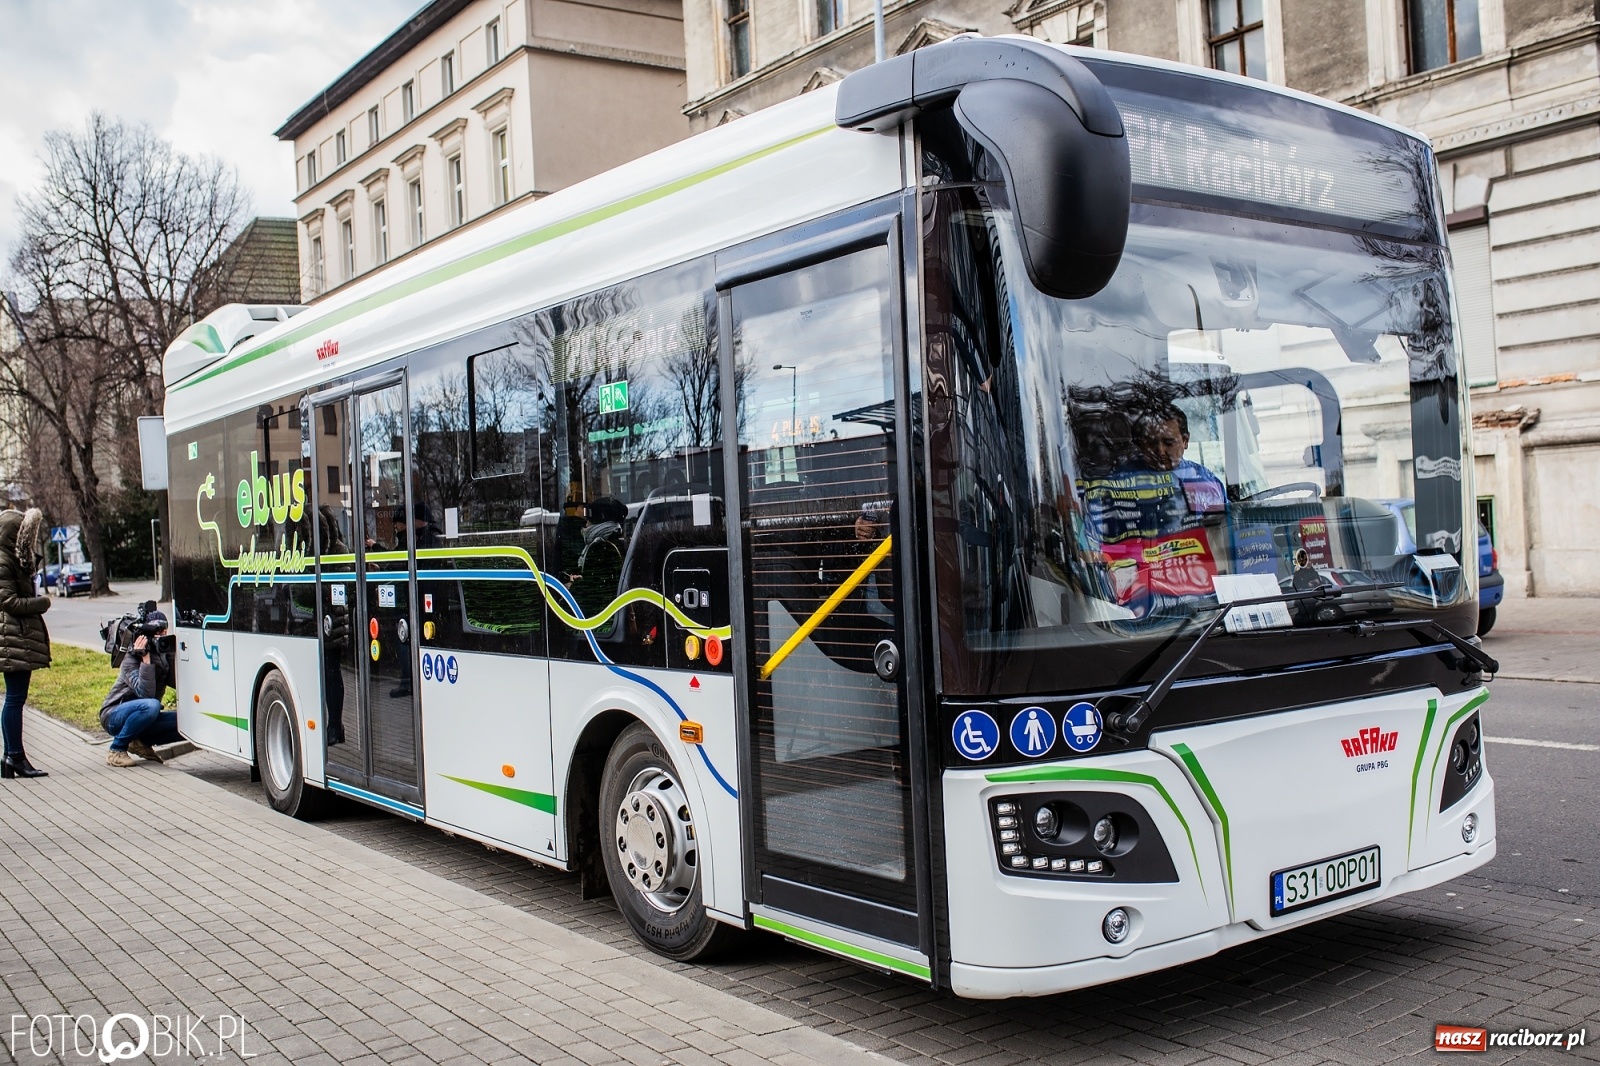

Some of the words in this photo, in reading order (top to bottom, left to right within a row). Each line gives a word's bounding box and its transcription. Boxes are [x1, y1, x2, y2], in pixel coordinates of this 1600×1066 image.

[1186, 125, 1335, 208] Racibórz
[236, 450, 305, 528] ebus
[237, 534, 277, 587] jedyny
[279, 531, 306, 573] taki
[1341, 727, 1399, 758] RAFAKO
[1356, 763, 1376, 773] GRUPA
[1377, 760, 1389, 769] PBG
[1286, 867, 1319, 903] S31
[1326, 852, 1376, 892] 00P01
[1275, 896, 1283, 905] PL
[646, 923, 662, 939] HS3
